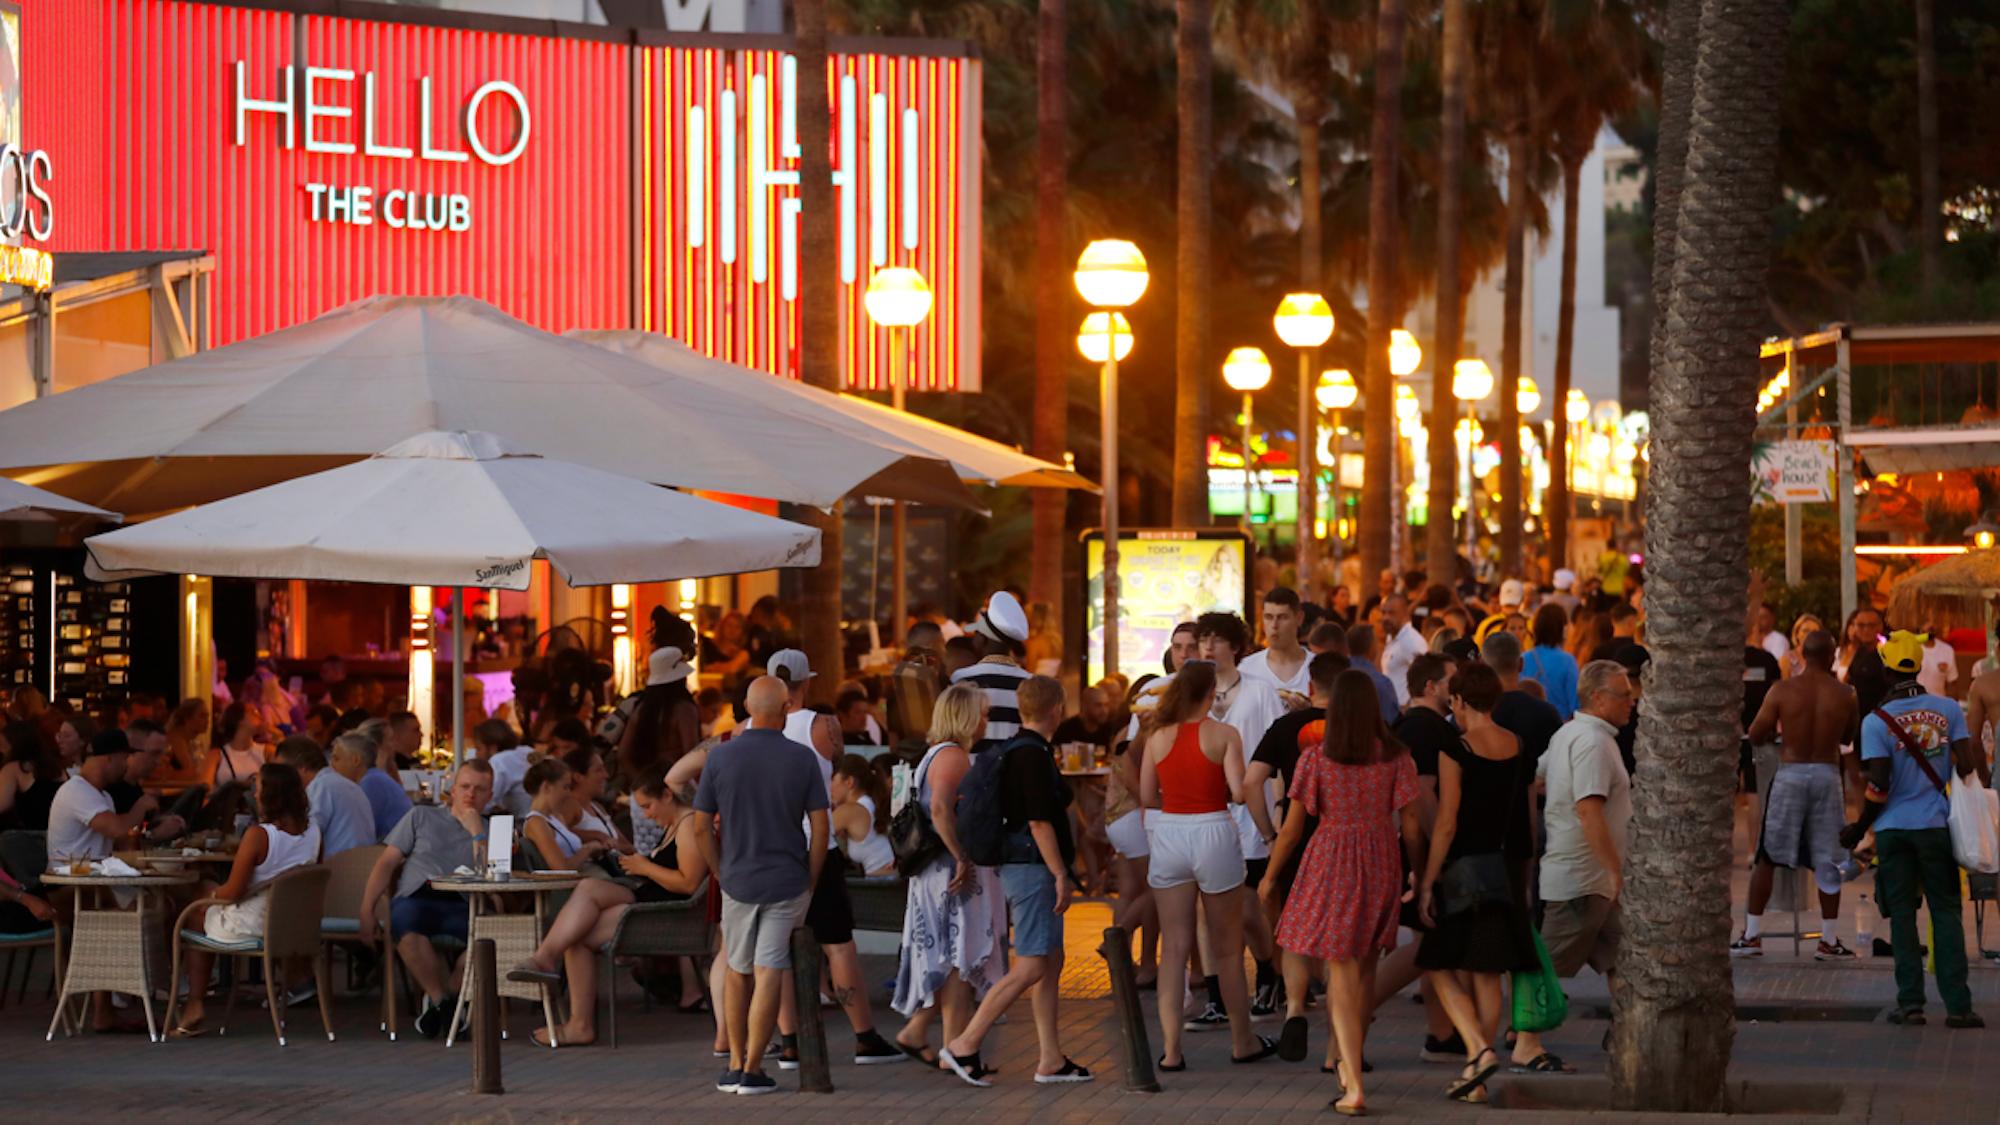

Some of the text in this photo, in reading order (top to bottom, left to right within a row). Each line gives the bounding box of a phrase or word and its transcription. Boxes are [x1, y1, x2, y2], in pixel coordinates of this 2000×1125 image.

[236, 60, 531, 166] HELLO
[0, 142, 53, 242] OS
[304, 183, 471, 232] THE CLUB
[1782, 469, 1819, 484] house
[1784, 455, 1822, 470] Beach
[1147, 546, 1181, 554] TODAY
